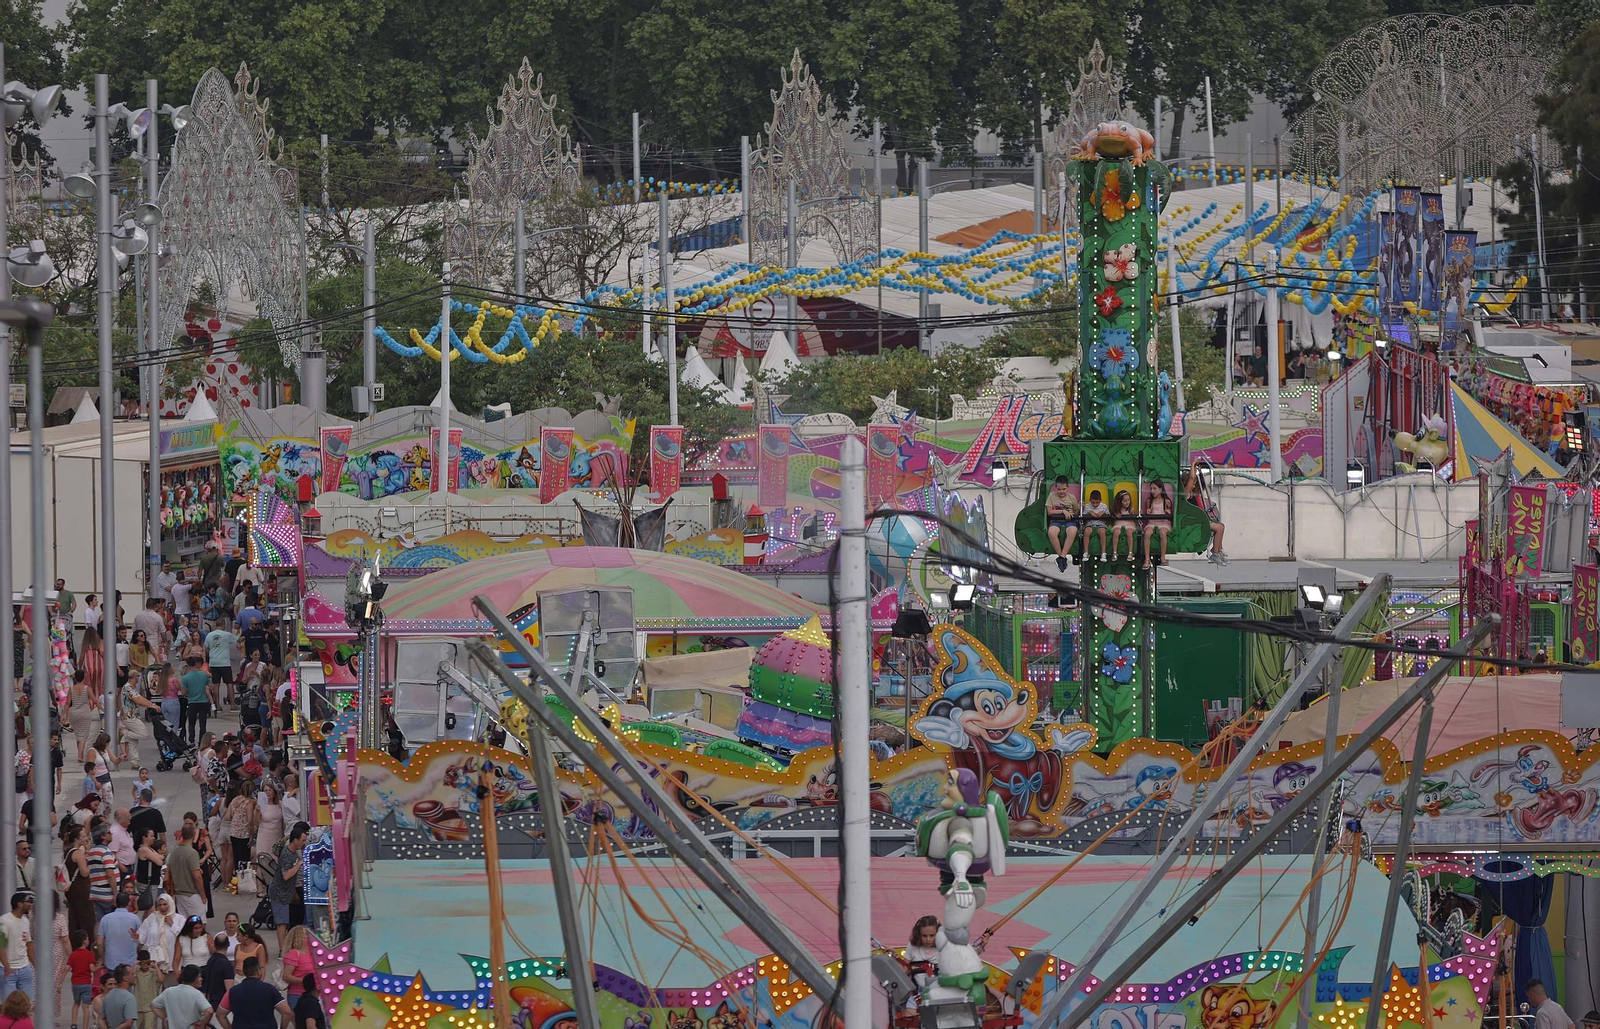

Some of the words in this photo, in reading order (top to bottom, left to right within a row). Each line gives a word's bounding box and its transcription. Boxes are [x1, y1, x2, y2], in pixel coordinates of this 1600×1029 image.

[448, 478, 455, 487] 5
[558, 478, 565, 487] 5
[670, 477, 677, 486] 5
[778, 476, 785, 485] 5
[886, 475, 893, 485] 5
